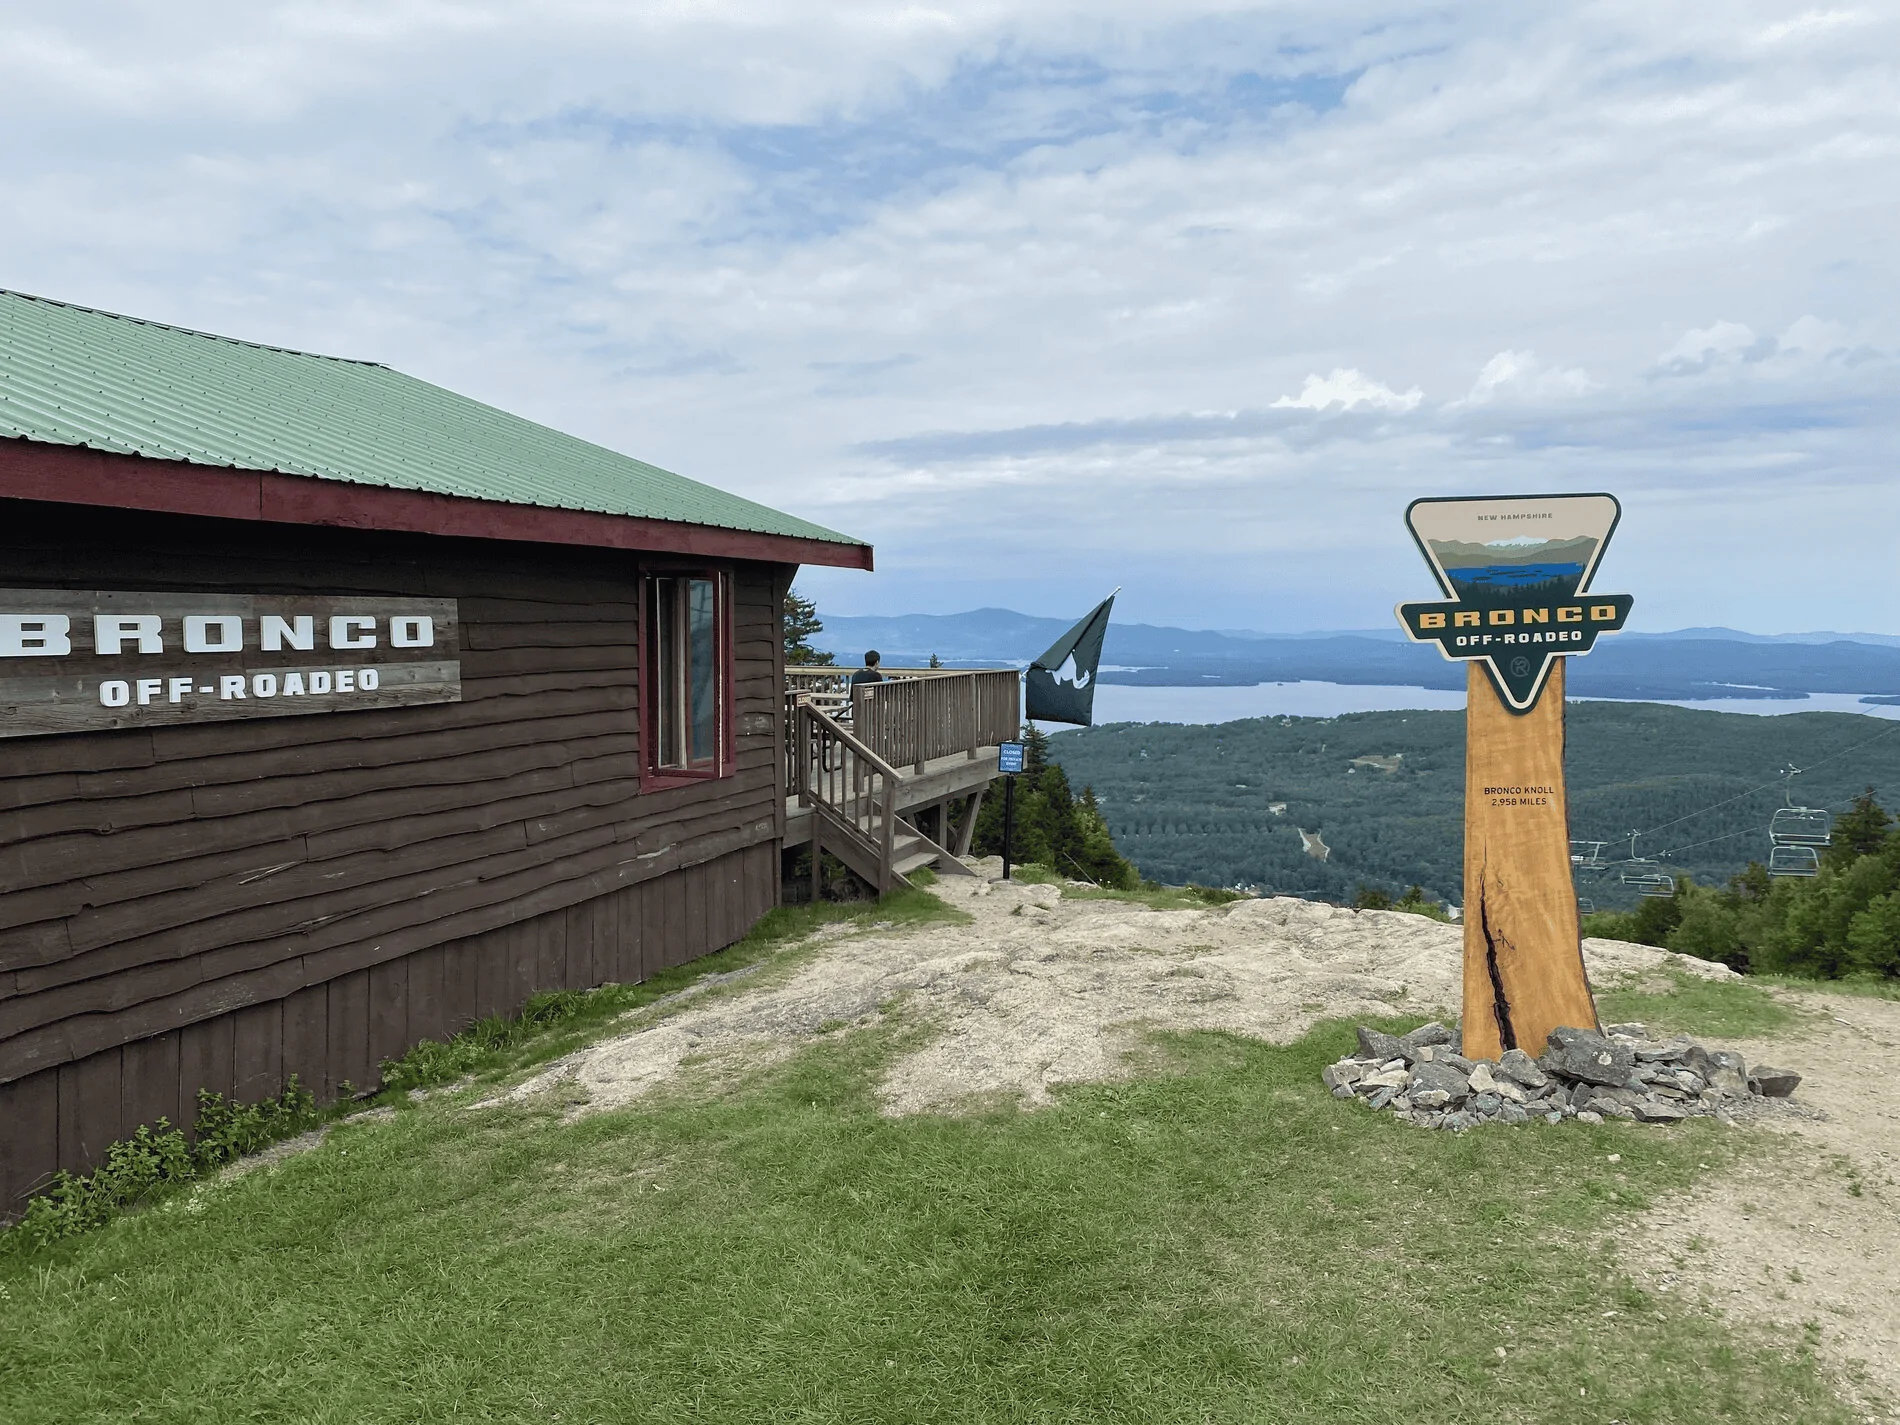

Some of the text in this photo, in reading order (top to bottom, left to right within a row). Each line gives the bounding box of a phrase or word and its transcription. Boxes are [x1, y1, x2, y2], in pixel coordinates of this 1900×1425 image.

[1500, 512, 1553, 520] HAMPSHIRE
[1419, 605, 1616, 629] BRONCO
[0, 614, 435, 657] BRONCO
[1456, 630, 1582, 647] OFF-ROADEO
[99, 668, 380, 708] OFF-ROADEO
[1484, 786, 1554, 795] BRONCO KNOLL
[1491, 797, 1547, 807] 2,958 MILES
